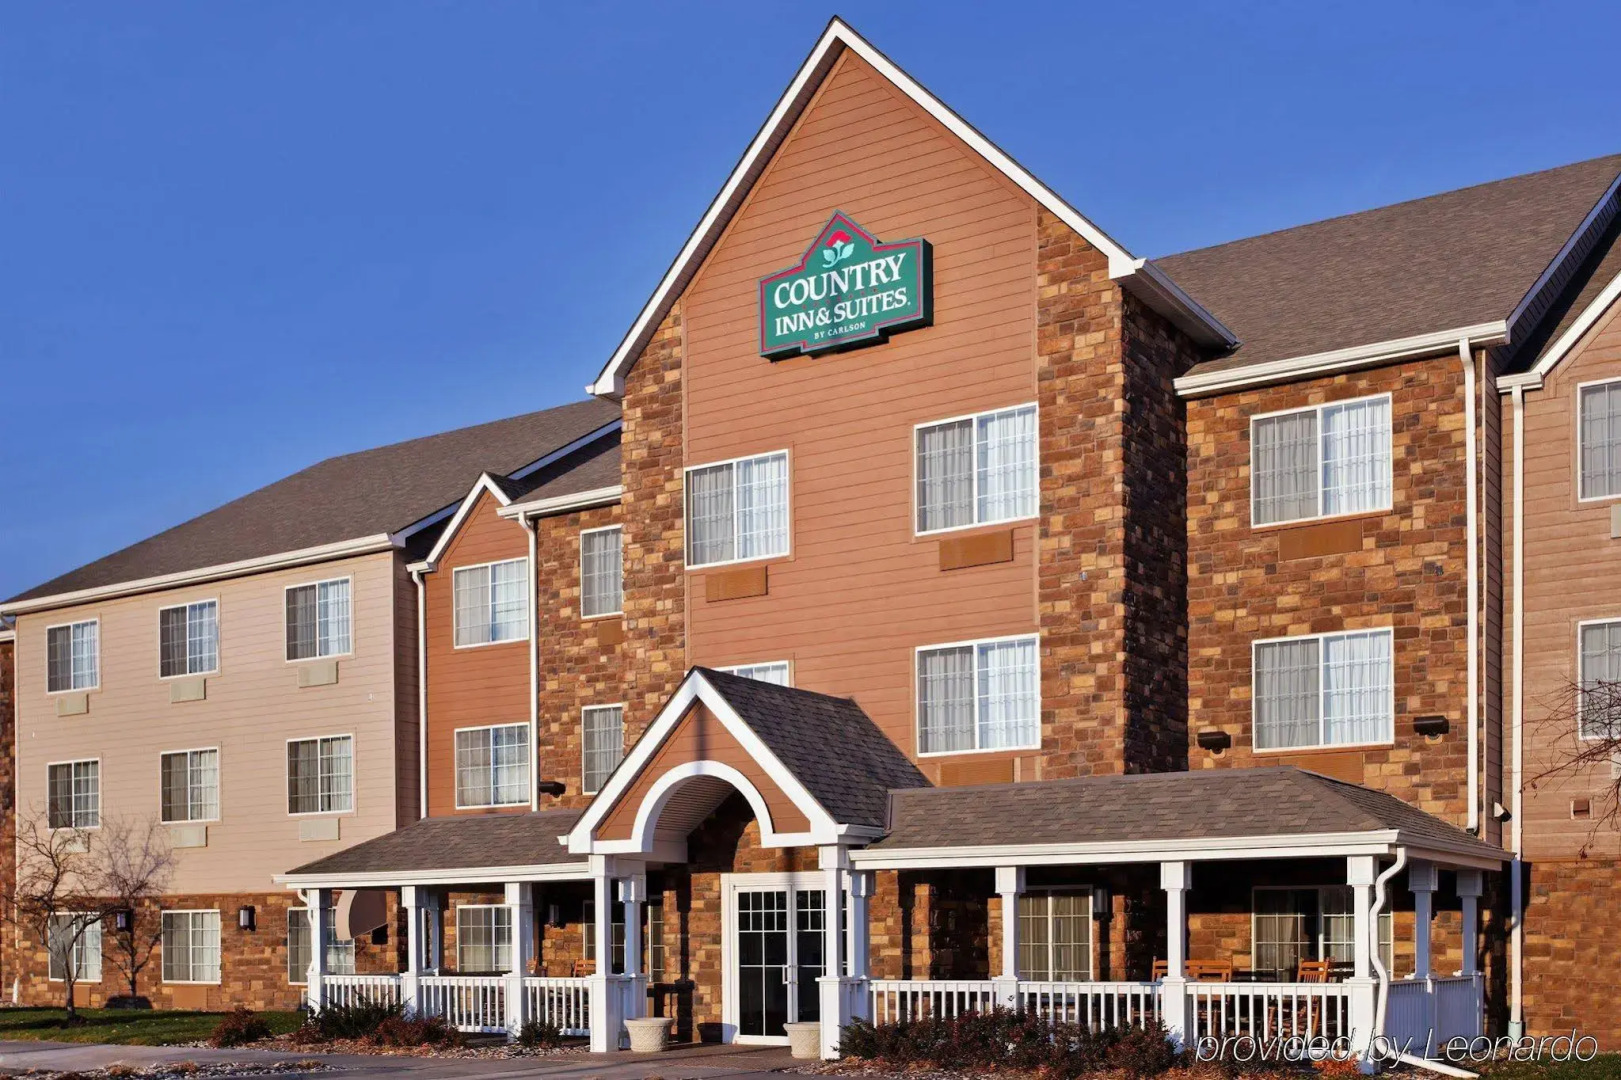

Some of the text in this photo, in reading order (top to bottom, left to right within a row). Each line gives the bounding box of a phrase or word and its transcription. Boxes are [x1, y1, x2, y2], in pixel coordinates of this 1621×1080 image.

[774, 253, 906, 309] COUNTRY
[814, 321, 866, 340] BY CARLSON
